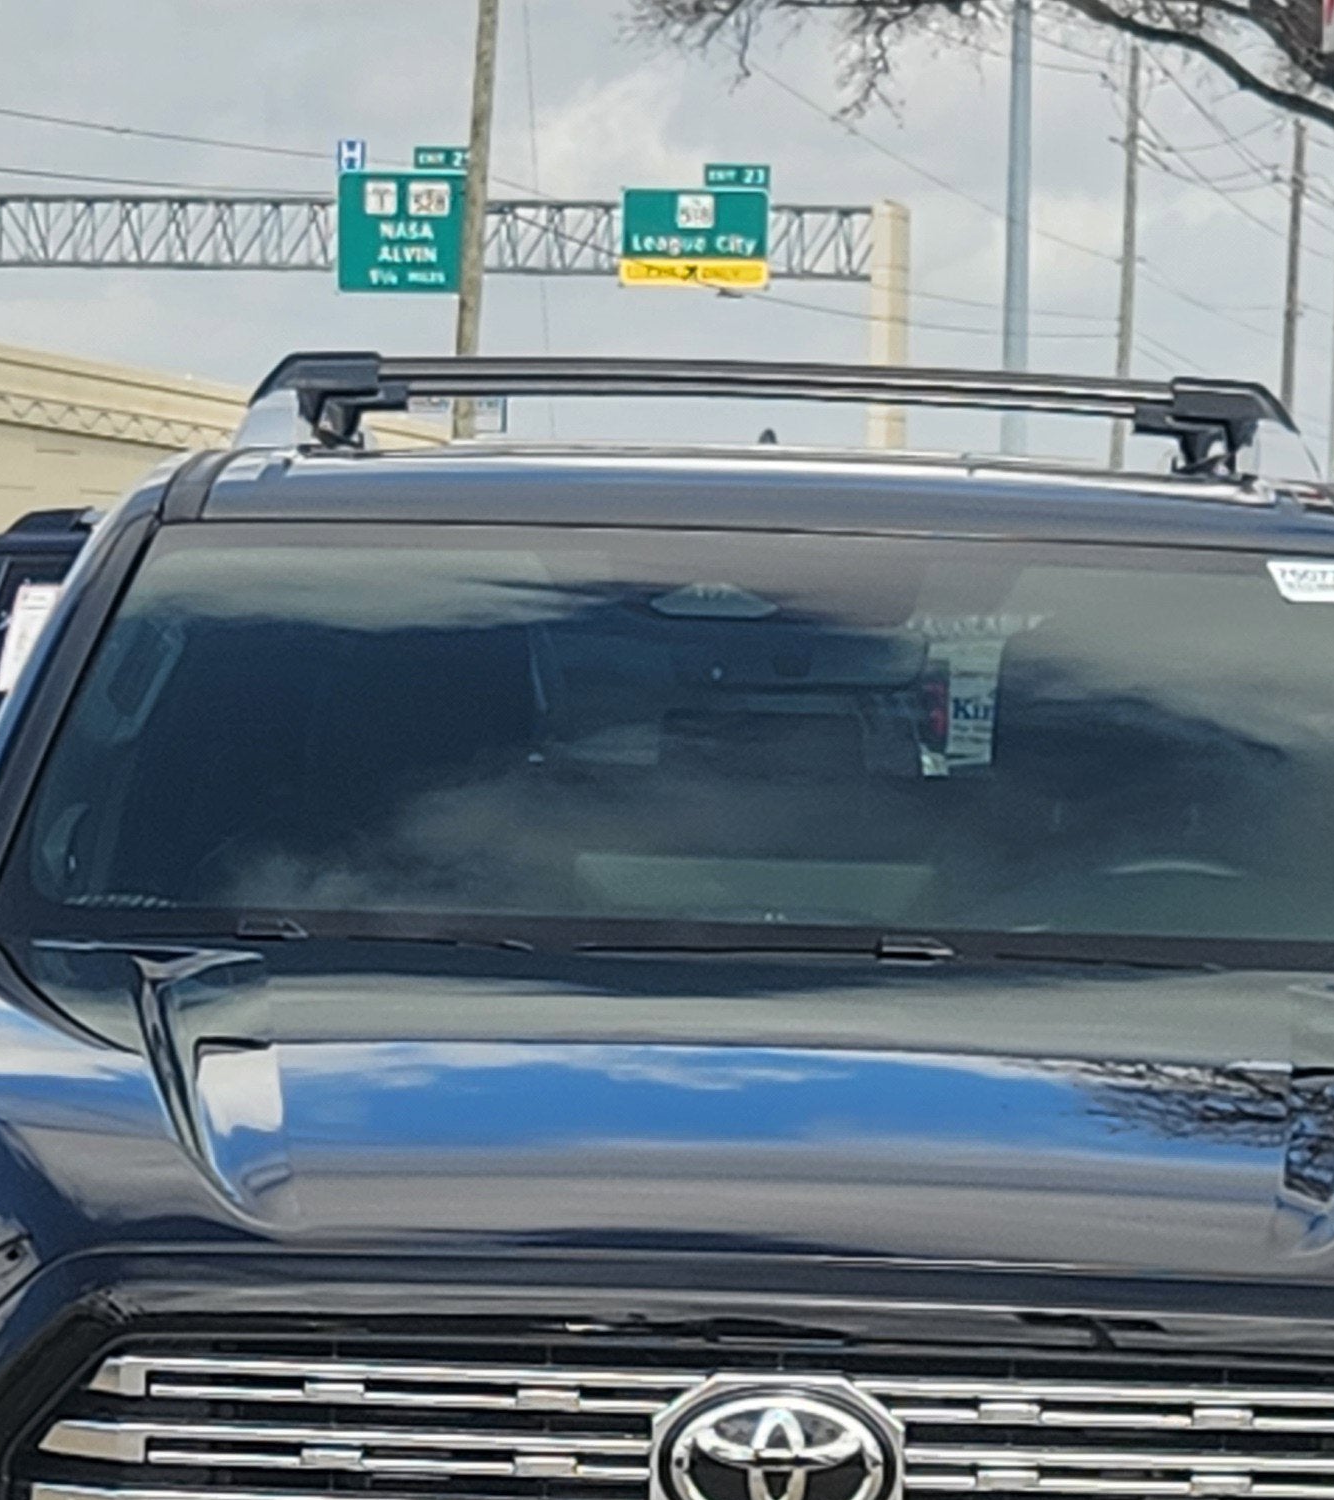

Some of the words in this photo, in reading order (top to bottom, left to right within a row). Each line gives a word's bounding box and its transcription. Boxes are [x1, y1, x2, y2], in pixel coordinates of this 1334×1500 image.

[743, 169, 765, 183] 23
[380, 221, 434, 240] NASA
[631, 233, 706, 256] League
[714, 234, 757, 256] City
[377, 246, 438, 263] ALVIN
